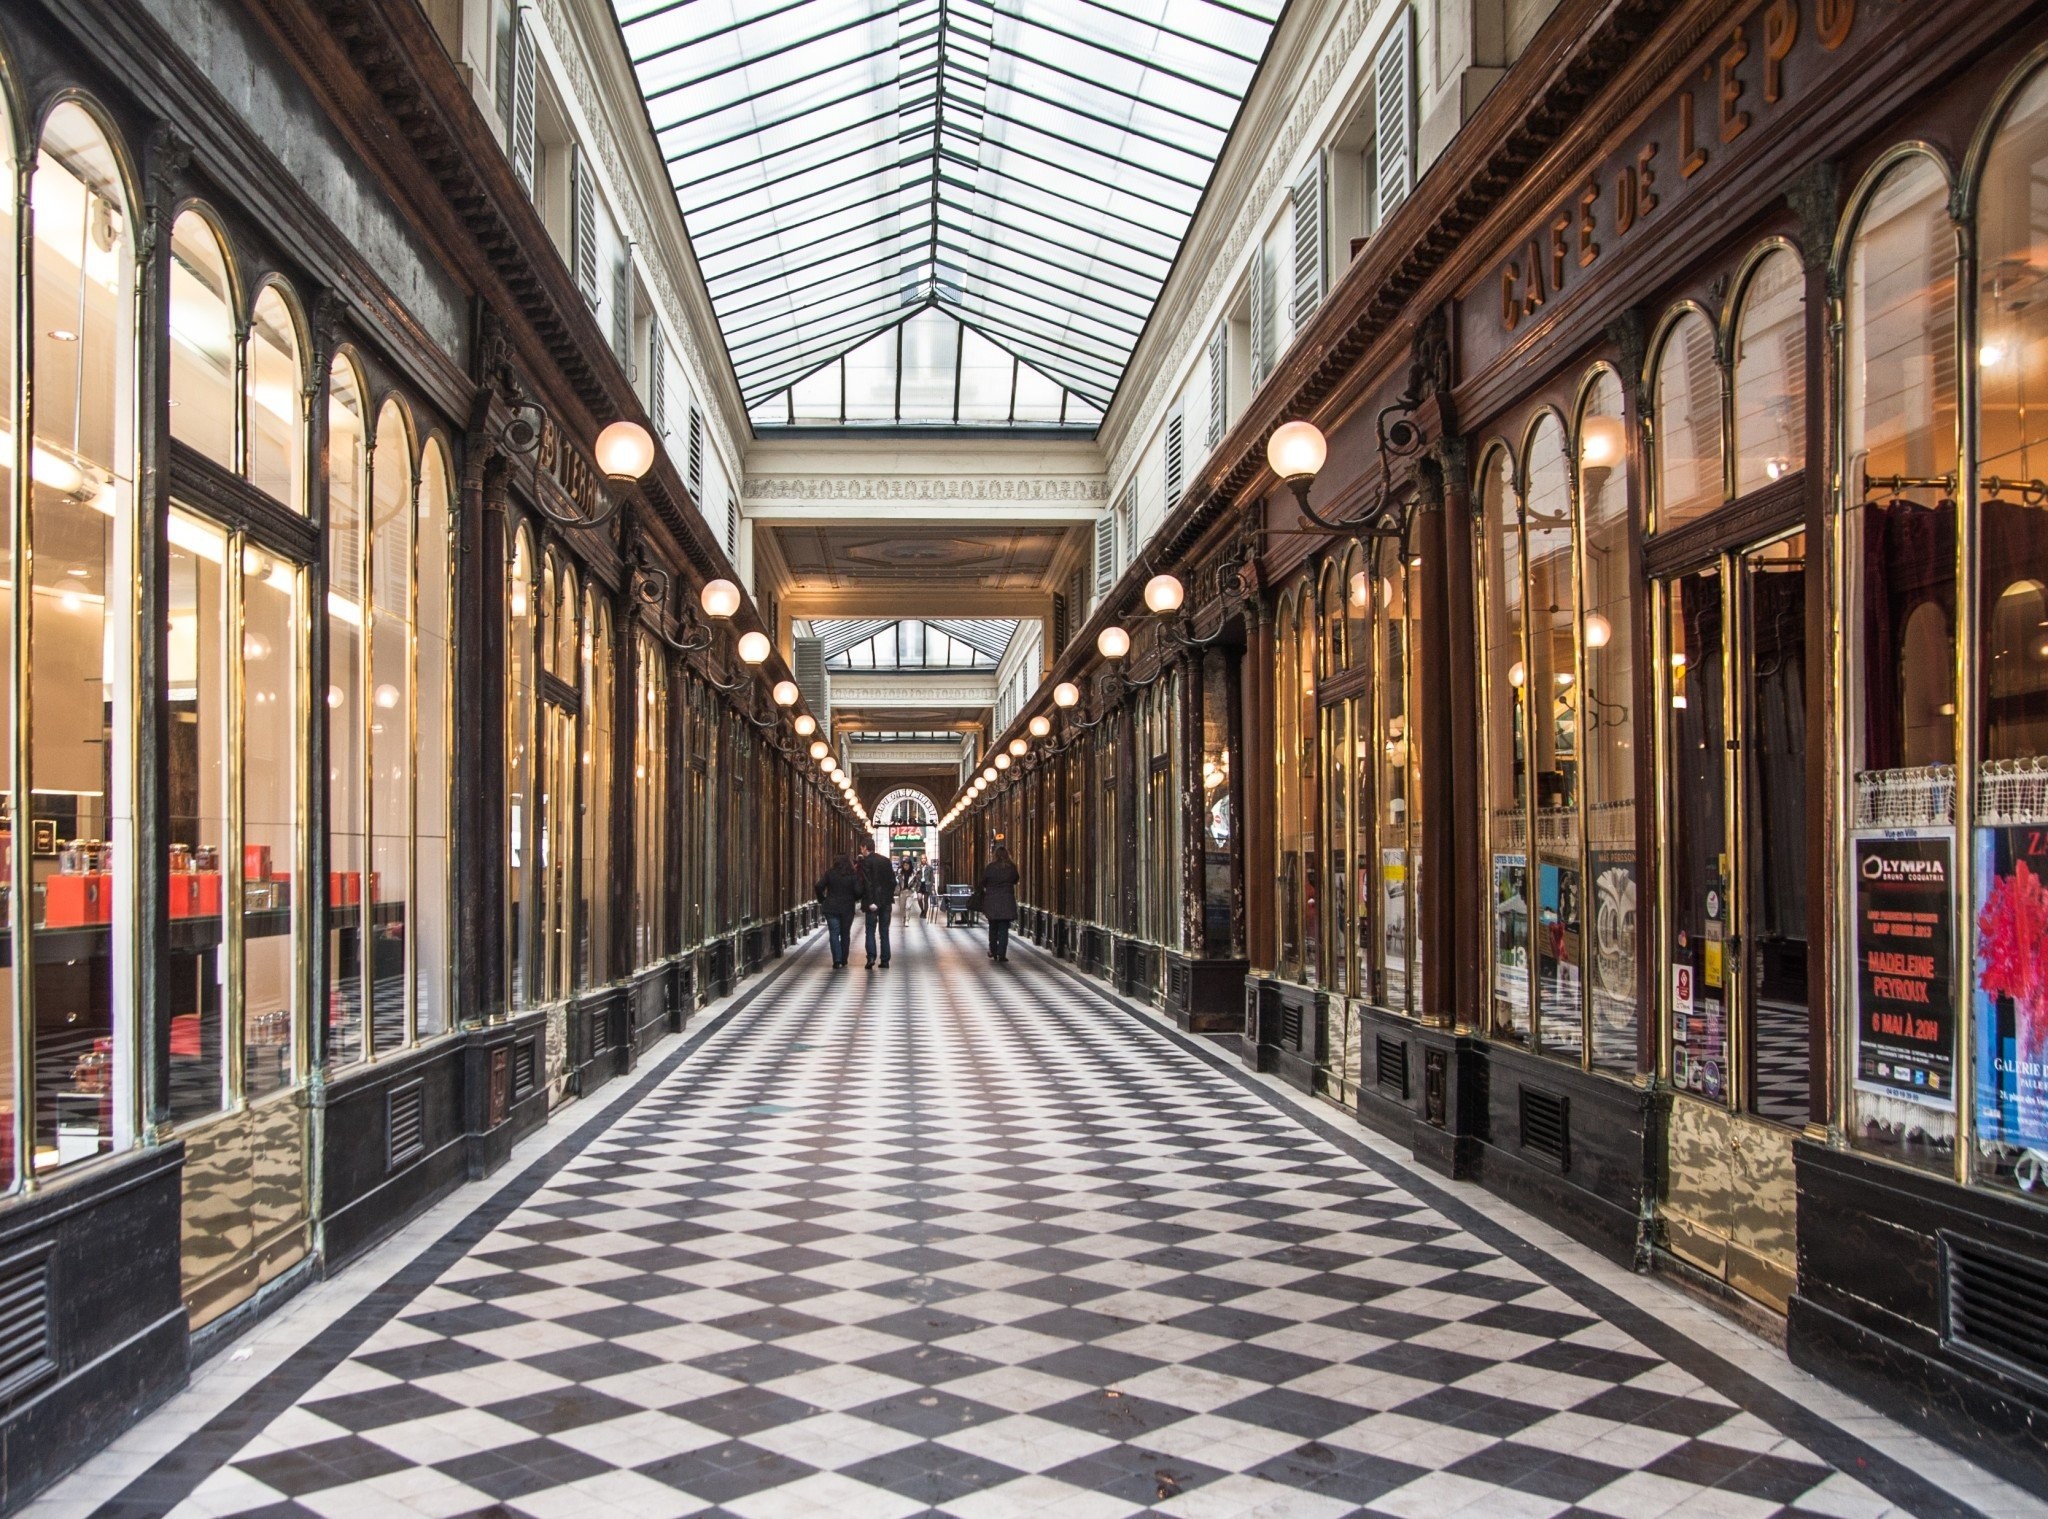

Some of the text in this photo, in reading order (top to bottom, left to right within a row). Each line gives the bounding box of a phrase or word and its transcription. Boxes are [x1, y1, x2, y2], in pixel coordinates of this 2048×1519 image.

[1502, 173, 1599, 332] CAFÉ
[1615, 142, 1658, 236] DE
[890, 826, 923, 837] PIZZA
[1862, 854, 1944, 879] OLYMPIA
[1882, 873, 1945, 882] BRUNO COQUATRIX
[1510, 945, 1527, 970] 13
[1867, 950, 1934, 979] MADELEINE
[1873, 976, 1930, 1003] PEYROUX
[1872, 1012, 1880, 1032] 6
[1881, 1013, 1903, 1035] MAI
[1915, 1019, 1938, 1041] 20H
[1993, 1057, 2041, 1077] GALERIE
